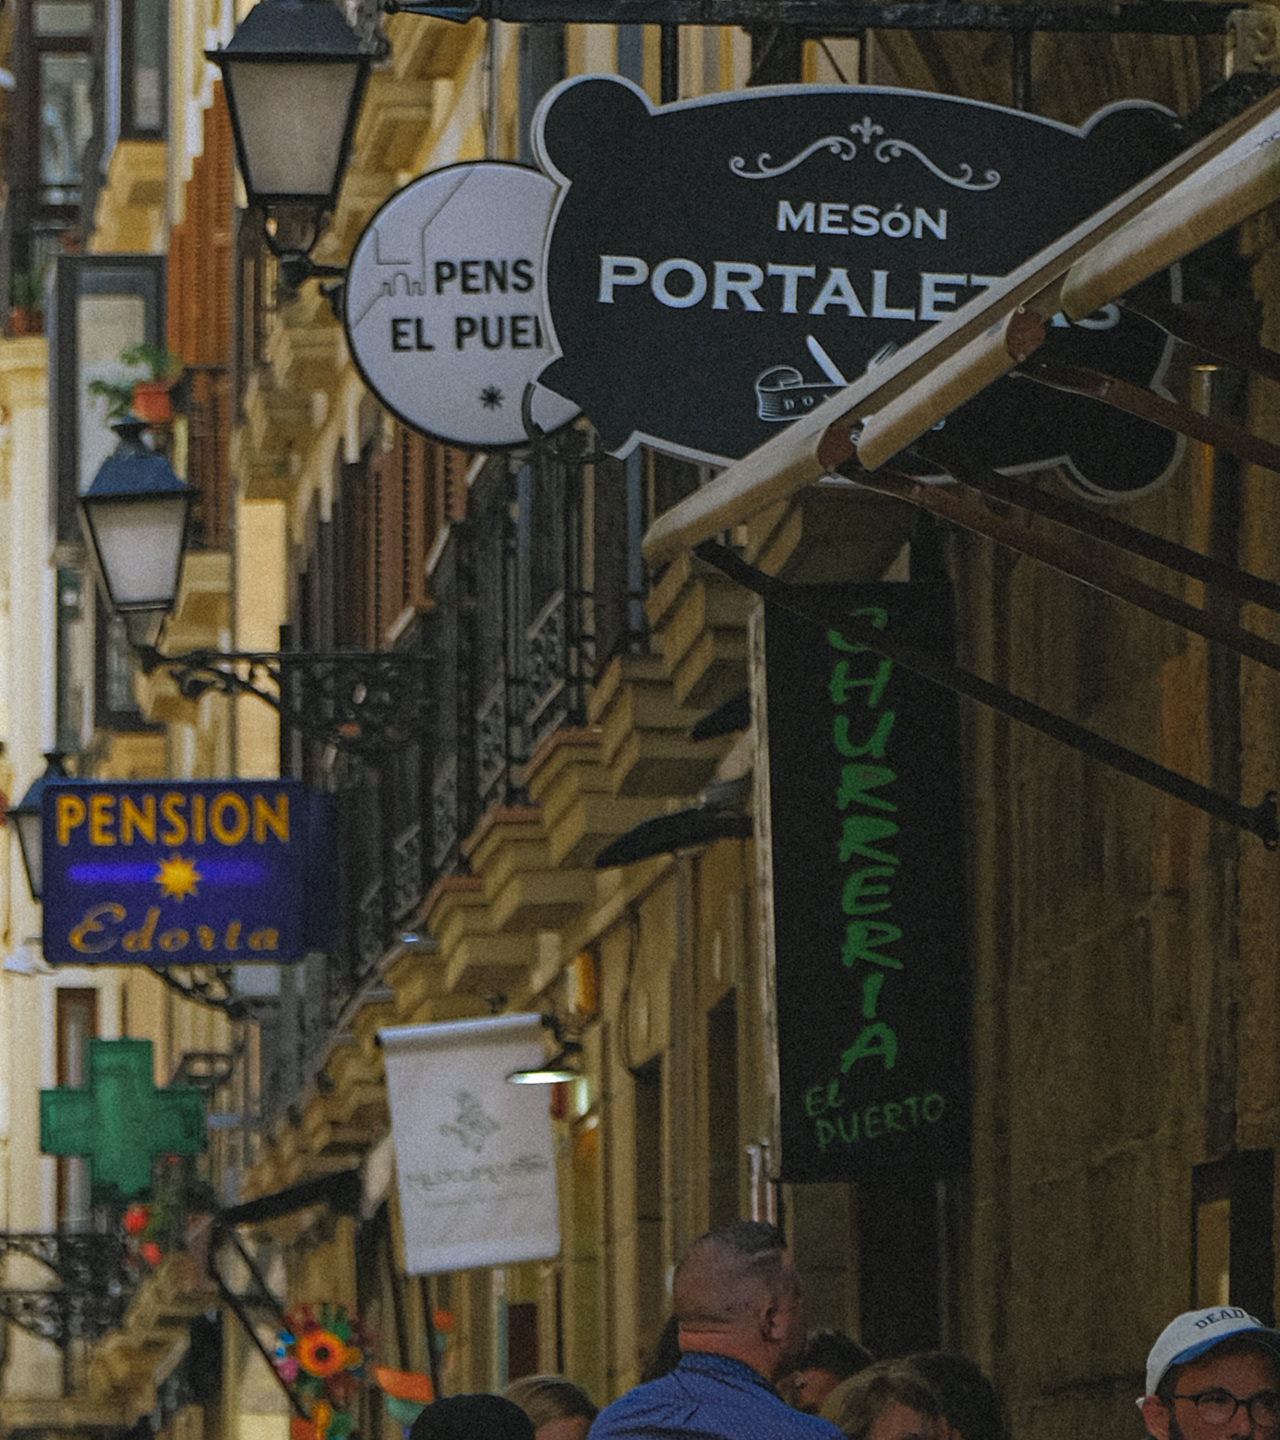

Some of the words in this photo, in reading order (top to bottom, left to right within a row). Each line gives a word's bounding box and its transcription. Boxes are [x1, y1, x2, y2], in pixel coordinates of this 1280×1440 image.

[596, 254, 1121, 331] PORTALE
[391, 317, 435, 352] EL
[55, 791, 290, 847] PENSION
[1195, 1309, 1245, 1329] DEAD
